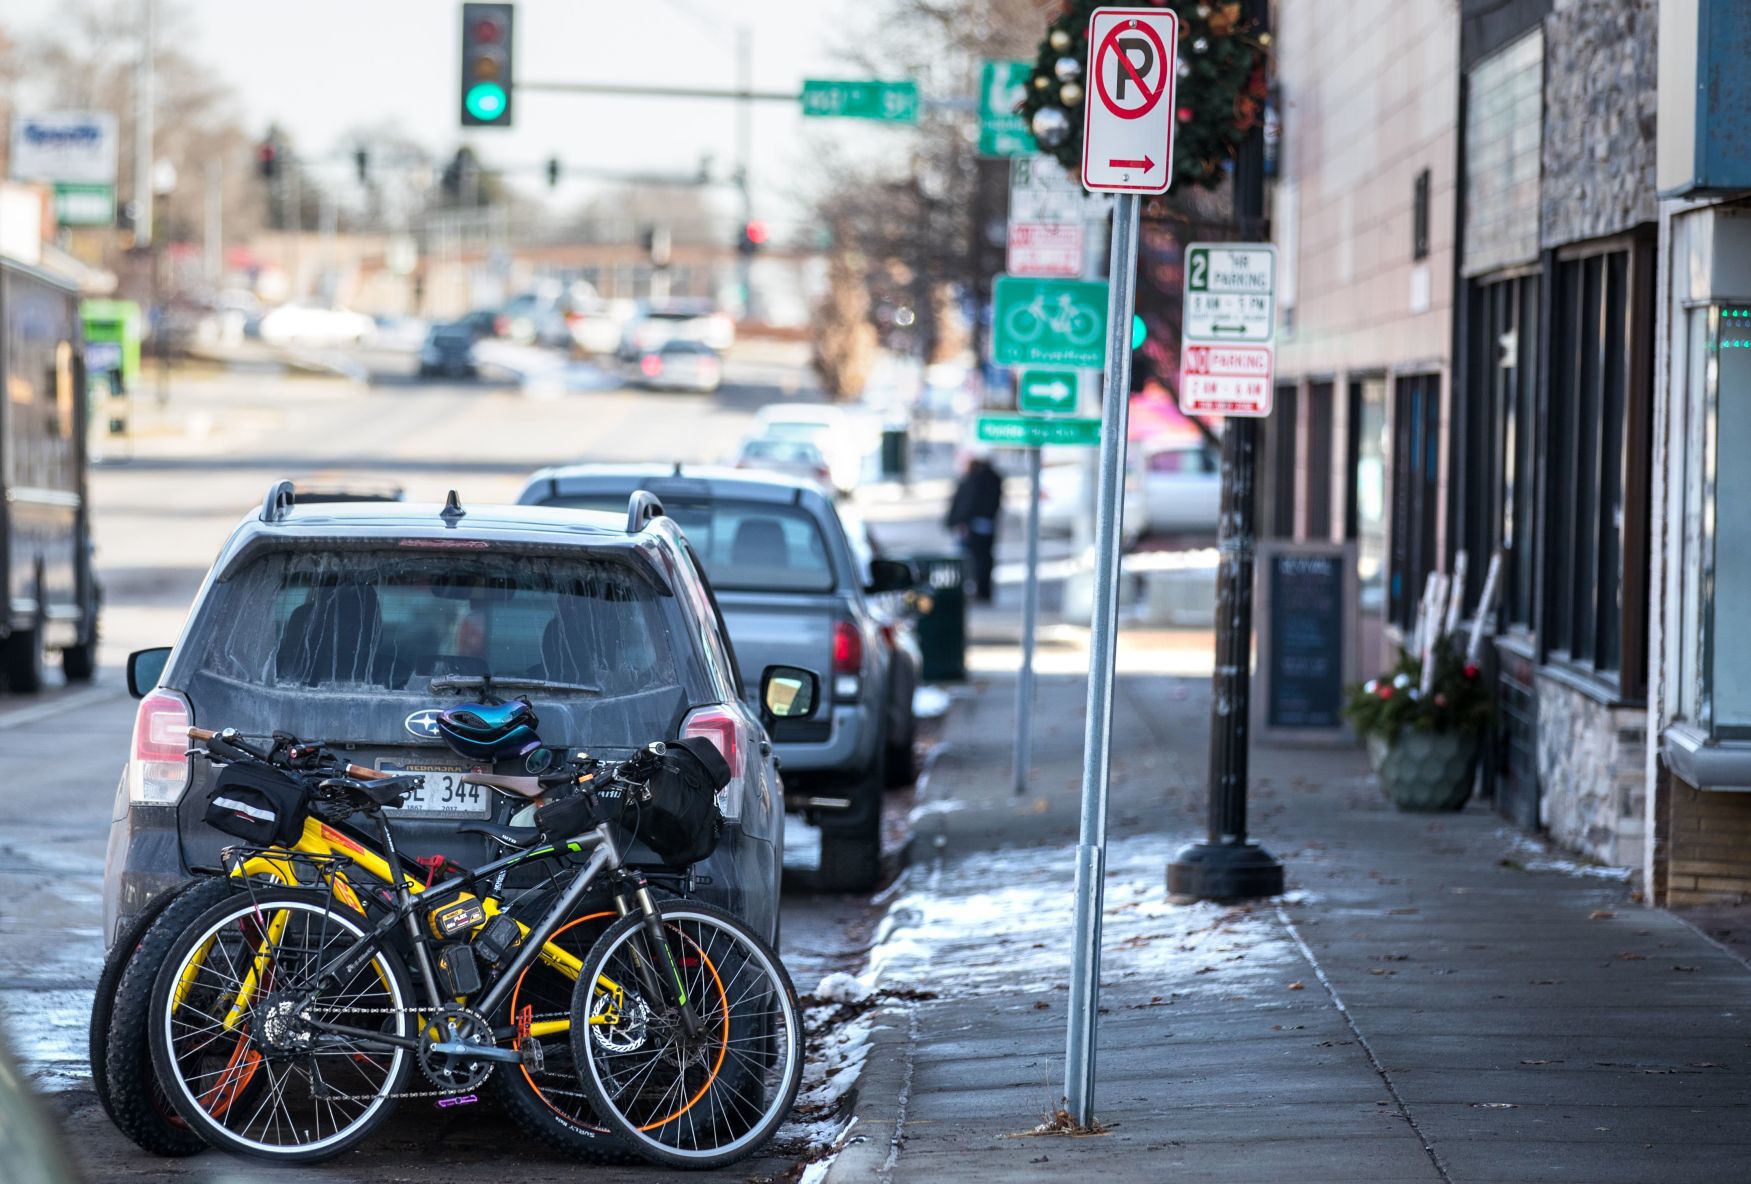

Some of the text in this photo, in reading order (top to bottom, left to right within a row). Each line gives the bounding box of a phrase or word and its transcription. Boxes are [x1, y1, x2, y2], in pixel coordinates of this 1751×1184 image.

[1116, 38, 1153, 99] P
[1192, 255, 1206, 287] 2
[1215, 272, 1265, 288] PARKING
[1186, 351, 1264, 371] NO PARKING
[441, 775, 480, 803] 344
[569, 1125, 596, 1138] SURLY
